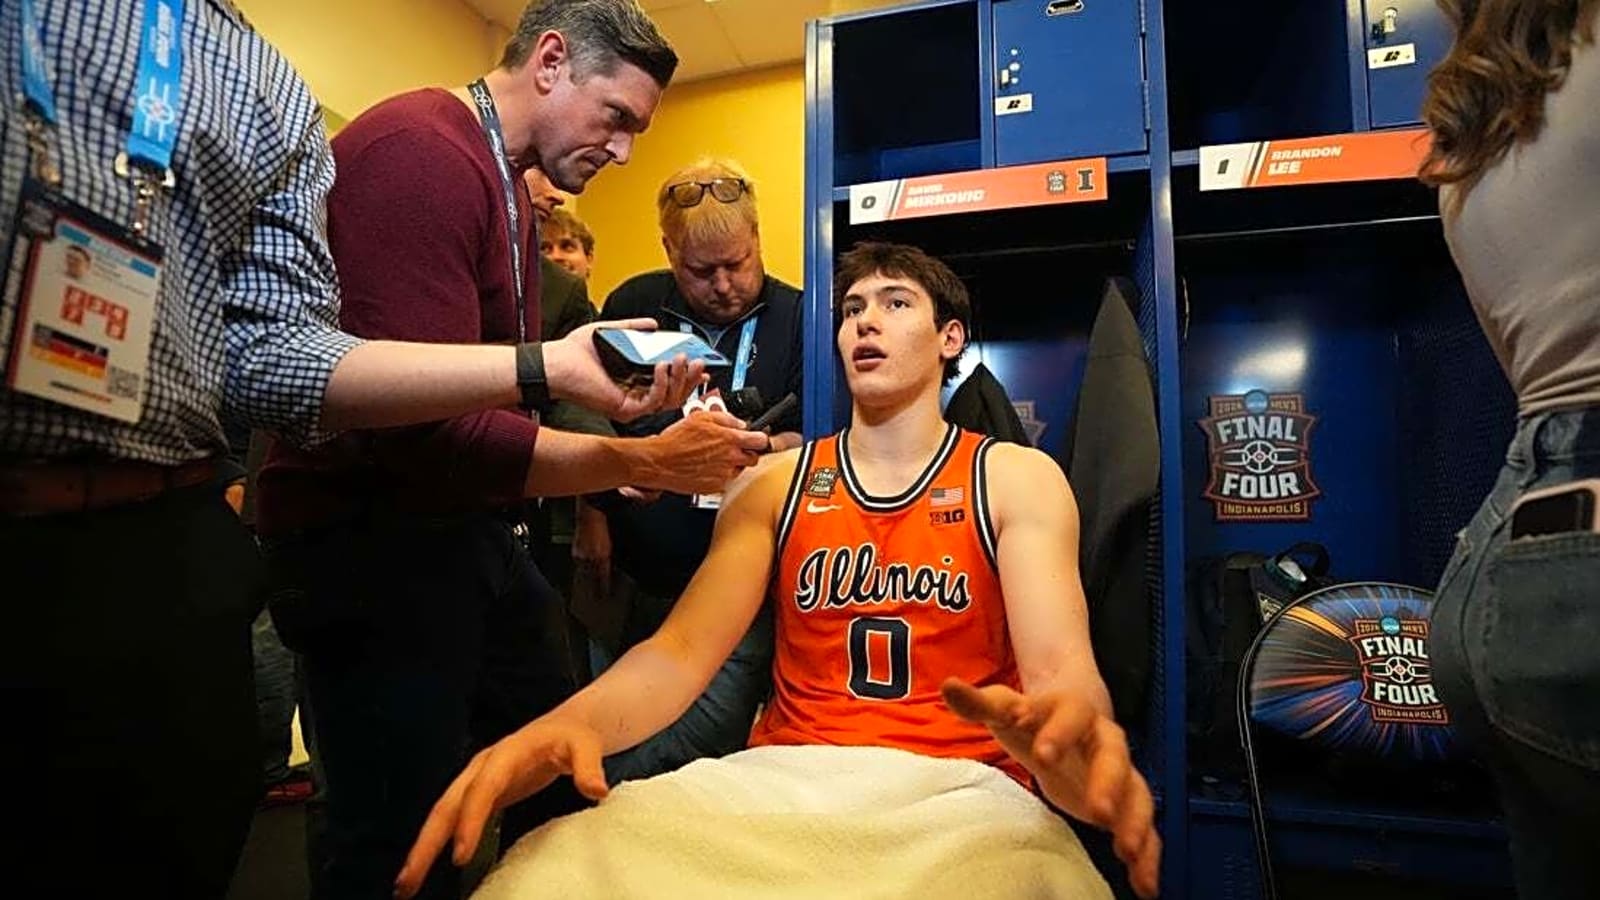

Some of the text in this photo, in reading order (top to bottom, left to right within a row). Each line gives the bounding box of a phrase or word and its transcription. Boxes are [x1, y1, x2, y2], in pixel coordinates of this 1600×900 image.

[1271, 146, 1343, 160] BRANDON
[1268, 161, 1302, 176] LEE
[1216, 416, 1297, 443] FINAL
[1221, 472, 1300, 498] FOUR
[1224, 502, 1301, 514] INDIANAPOLIS
[795, 542, 971, 613] Illinois
[847, 616, 911, 700] 0
[1360, 636, 1428, 659] FINAL
[1374, 681, 1439, 704] FOUR
[1377, 708, 1442, 720] INDIANAPOLIS
